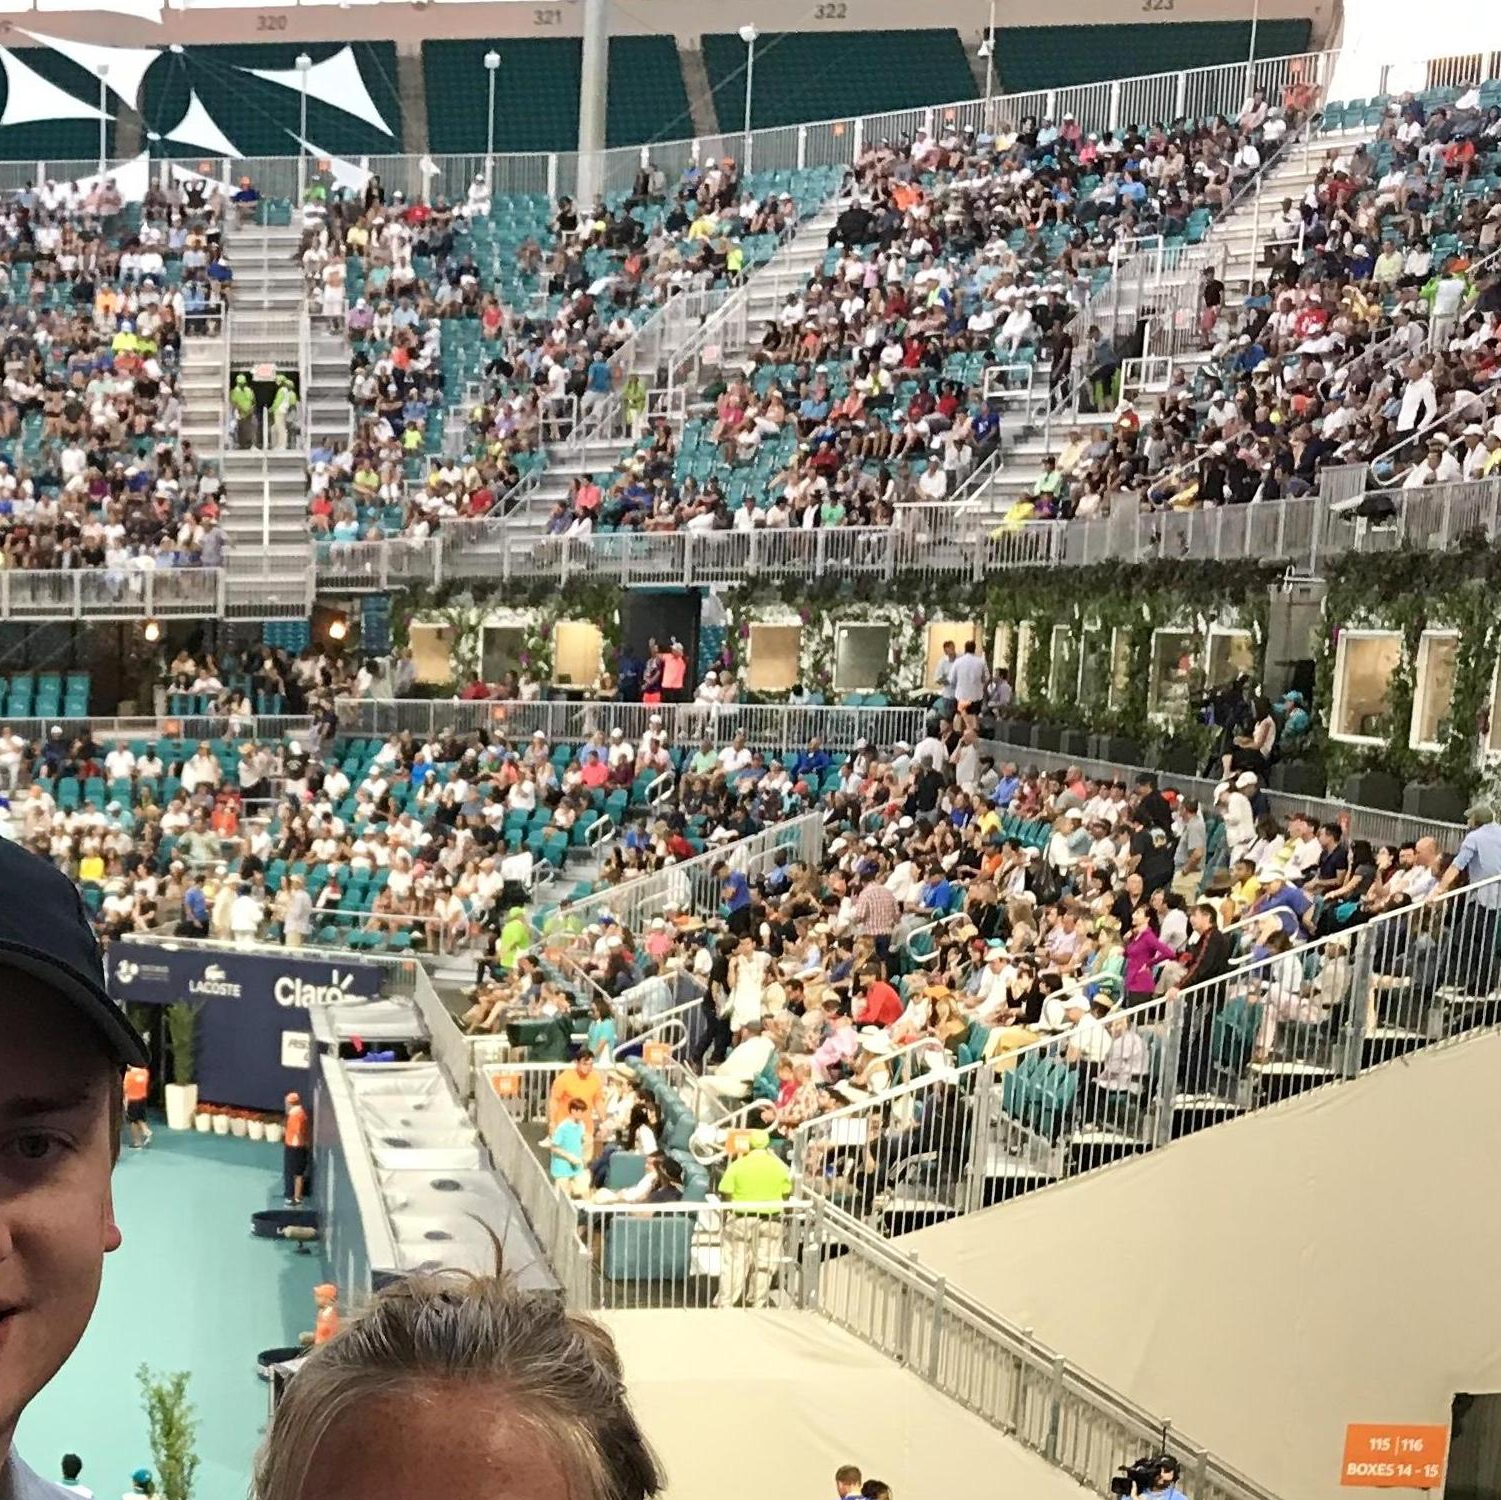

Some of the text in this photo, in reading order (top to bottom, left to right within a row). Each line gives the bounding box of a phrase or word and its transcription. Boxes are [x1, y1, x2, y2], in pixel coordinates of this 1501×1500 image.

[814, 3, 847, 20] 322
[1141, 0, 1174, 12] 323
[256, 15, 288, 31] 320
[533, 10, 562, 26] 321
[188, 979, 242, 998] LACOSTE
[1369, 1437, 1392, 1452] 115
[1401, 1438, 1424, 1453] 116
[1347, 1462, 1395, 1477] BOXES
[1396, 1463, 1413, 1477] 14
[1423, 1463, 1440, 1478] 15
